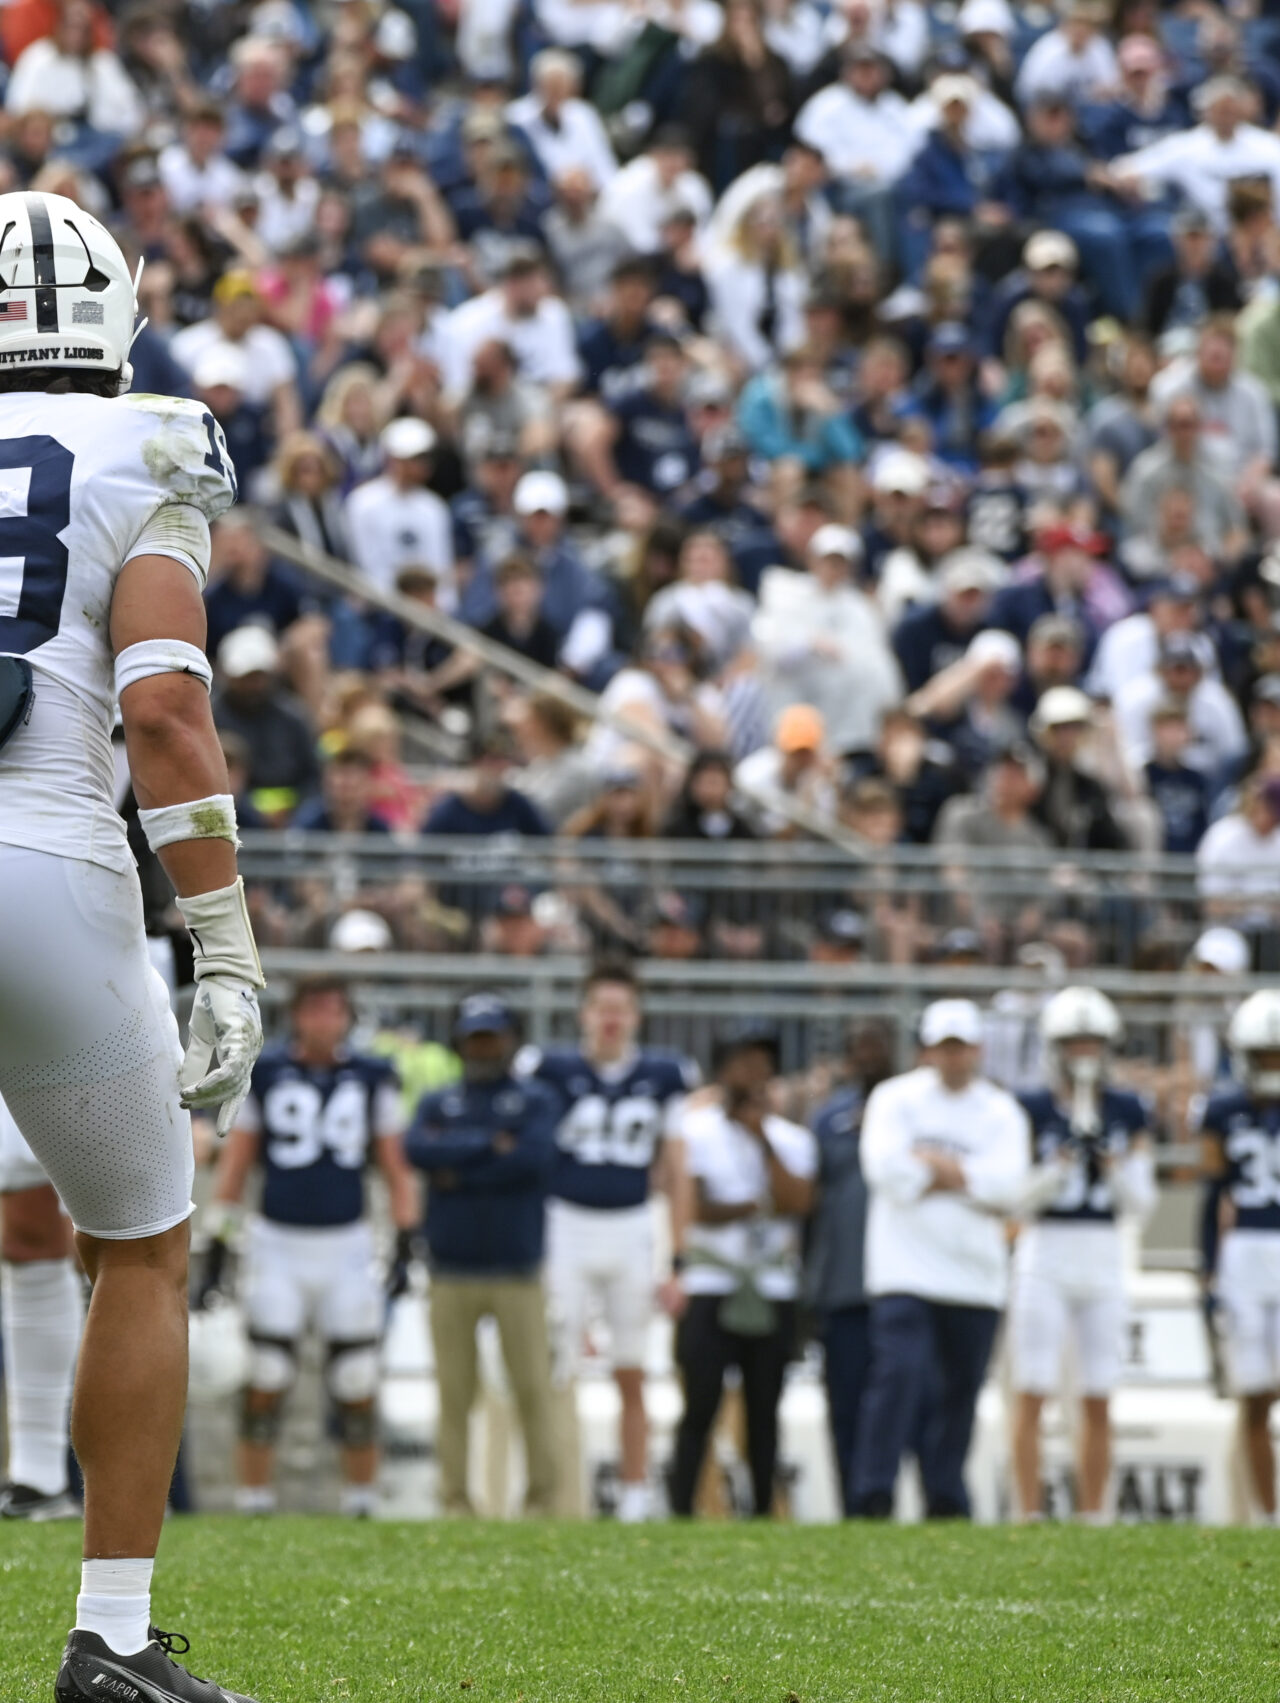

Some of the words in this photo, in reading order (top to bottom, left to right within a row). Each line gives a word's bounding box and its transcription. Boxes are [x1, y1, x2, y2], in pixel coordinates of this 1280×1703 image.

[64, 347, 104, 360] LIONS
[264, 1081, 367, 1169] 94
[556, 1096, 656, 1167] 40
[100, 1675, 139, 1700] VAPOR
